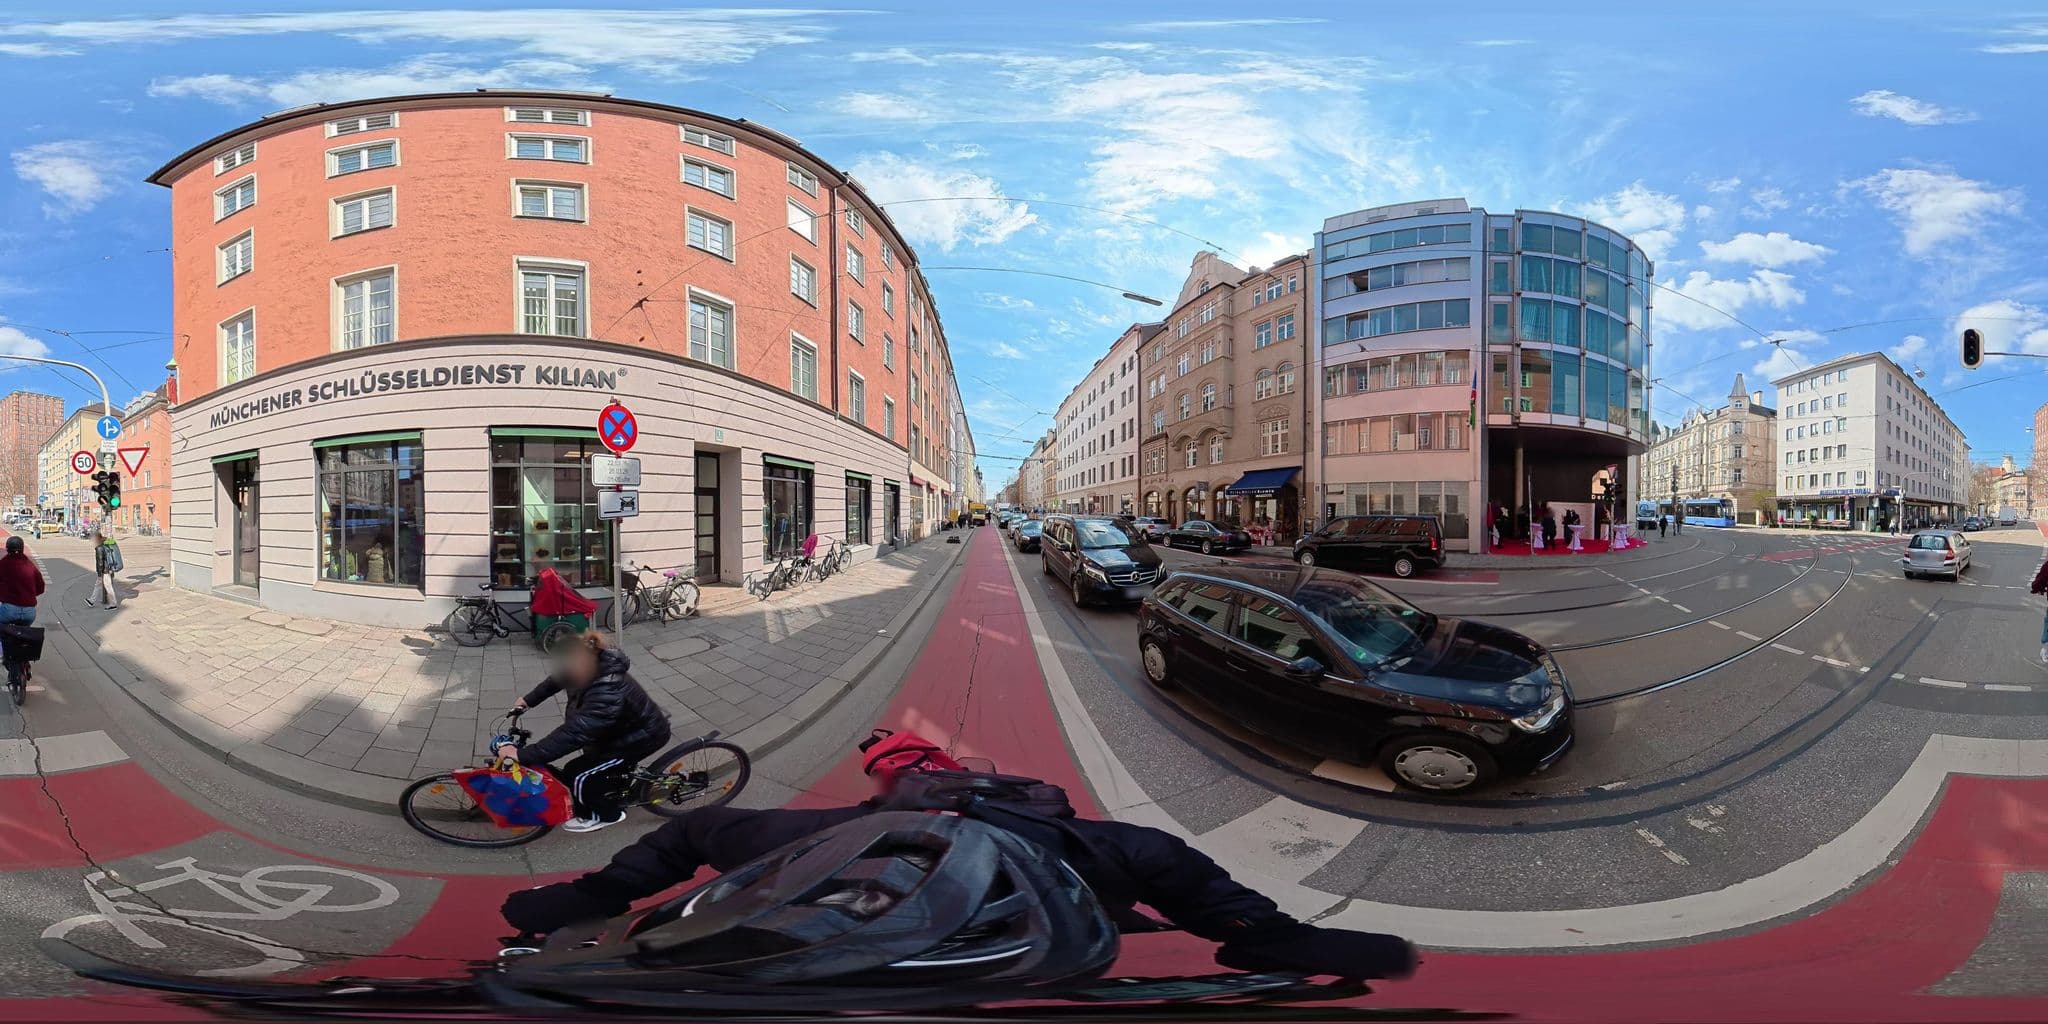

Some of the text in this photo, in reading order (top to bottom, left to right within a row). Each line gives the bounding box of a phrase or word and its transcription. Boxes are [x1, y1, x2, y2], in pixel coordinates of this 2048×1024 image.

[210, 389, 302, 428] MÜNCHENER
[308, 364, 525, 403] SCHLÜSSELDIENST
[78, 457, 91, 468] 50
